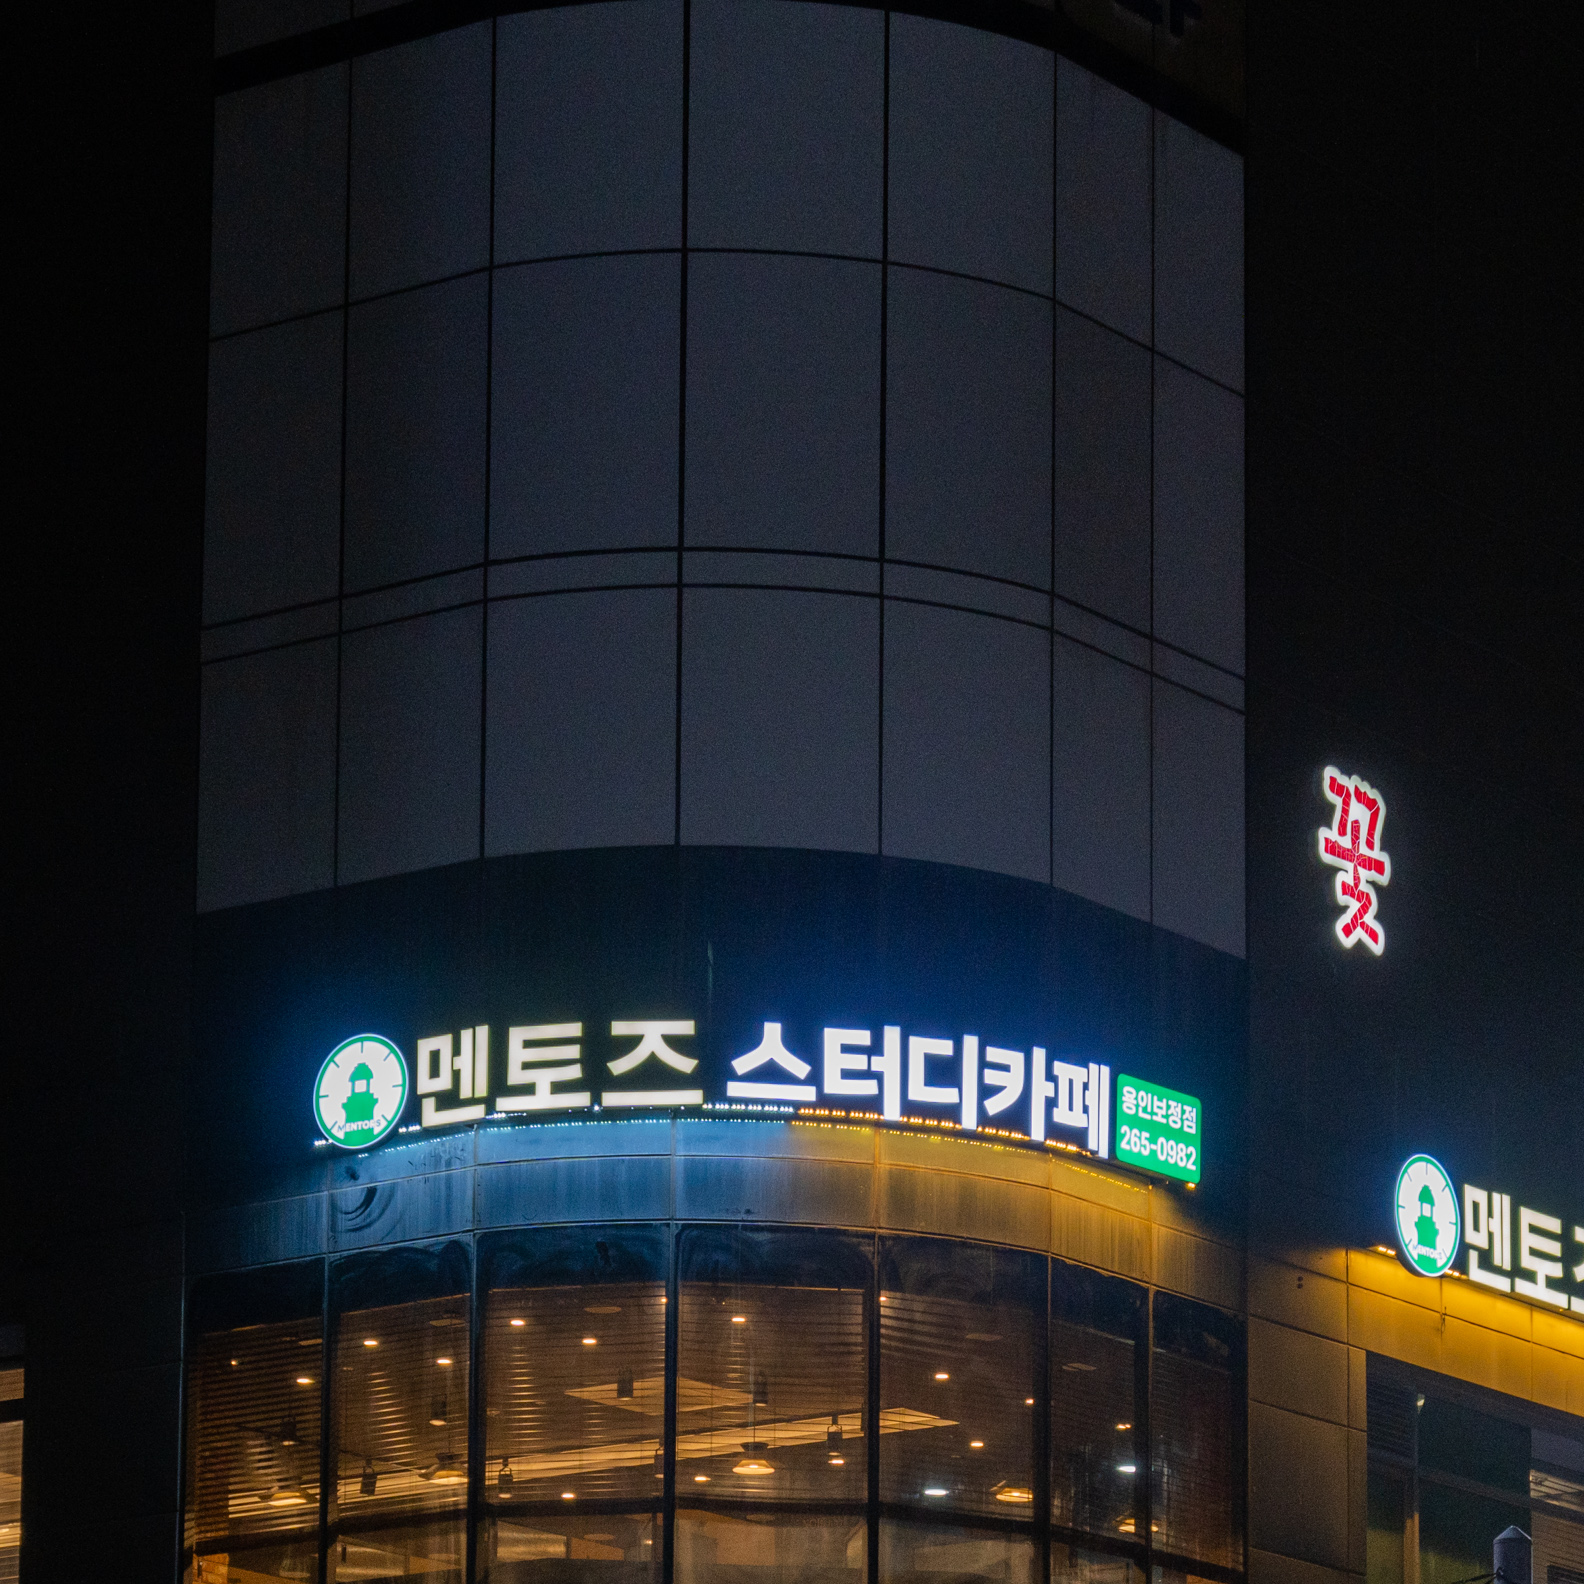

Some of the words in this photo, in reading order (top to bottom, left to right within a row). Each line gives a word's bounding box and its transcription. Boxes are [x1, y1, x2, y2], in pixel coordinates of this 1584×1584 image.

[416, 1019, 705, 1128] 멘토즈
[725, 1020, 1110, 1160] 스터디카페
[1121, 1084, 1198, 1136] 용인보정점
[1118, 1122, 1198, 1173] 265-0982
